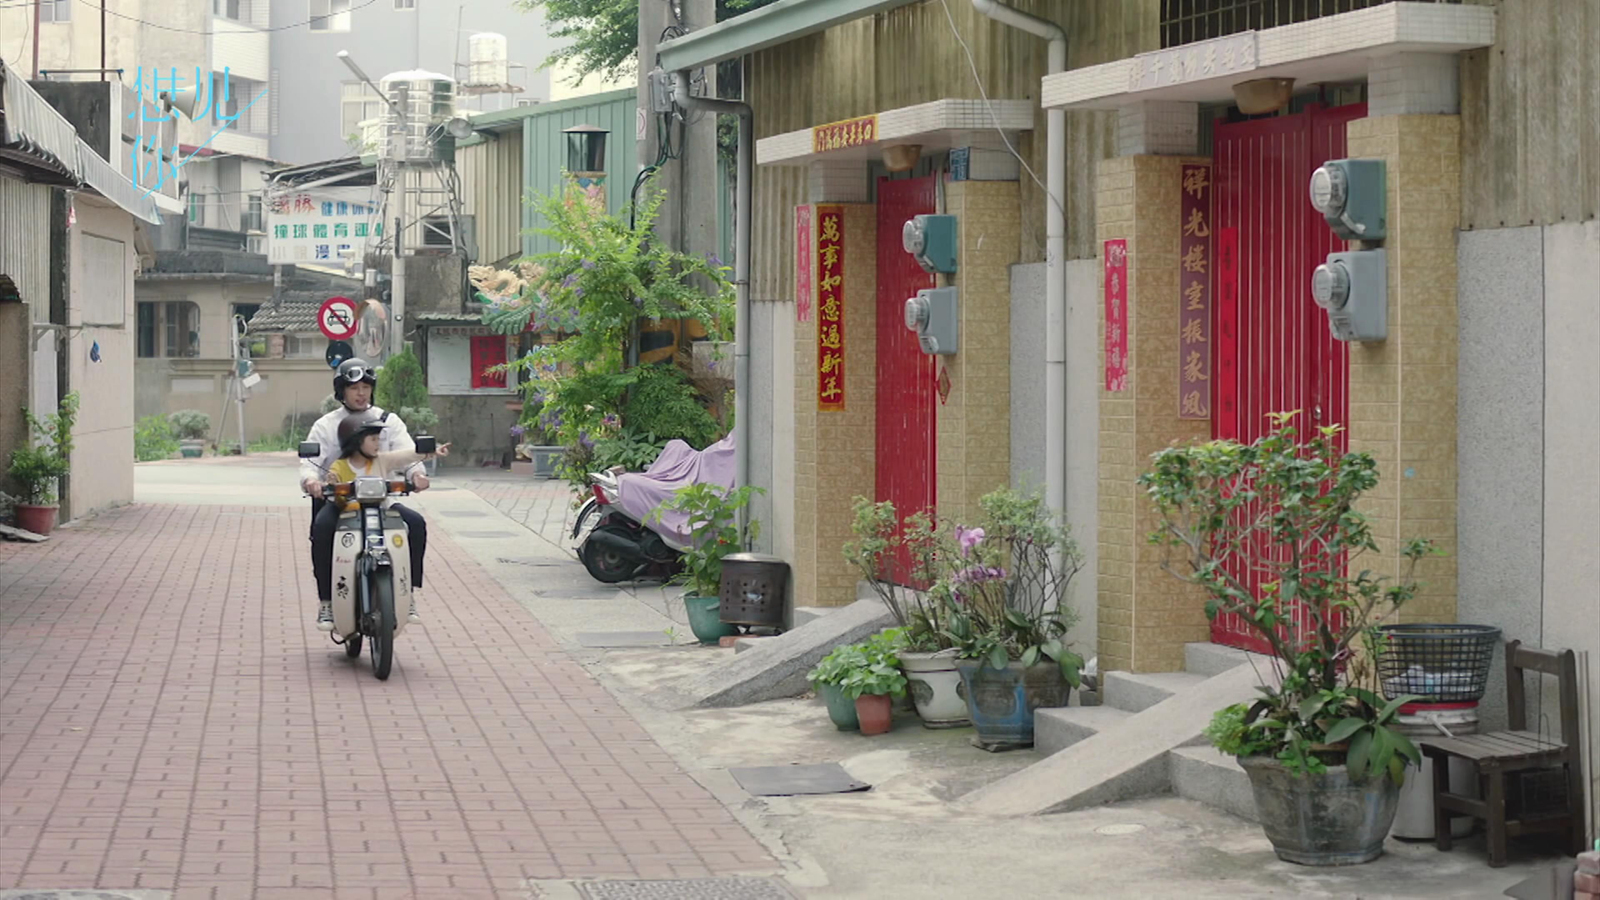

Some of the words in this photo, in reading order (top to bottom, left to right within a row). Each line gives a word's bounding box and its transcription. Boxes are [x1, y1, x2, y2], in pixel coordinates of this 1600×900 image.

[820, 215, 842, 400] 萬事如意過新年
